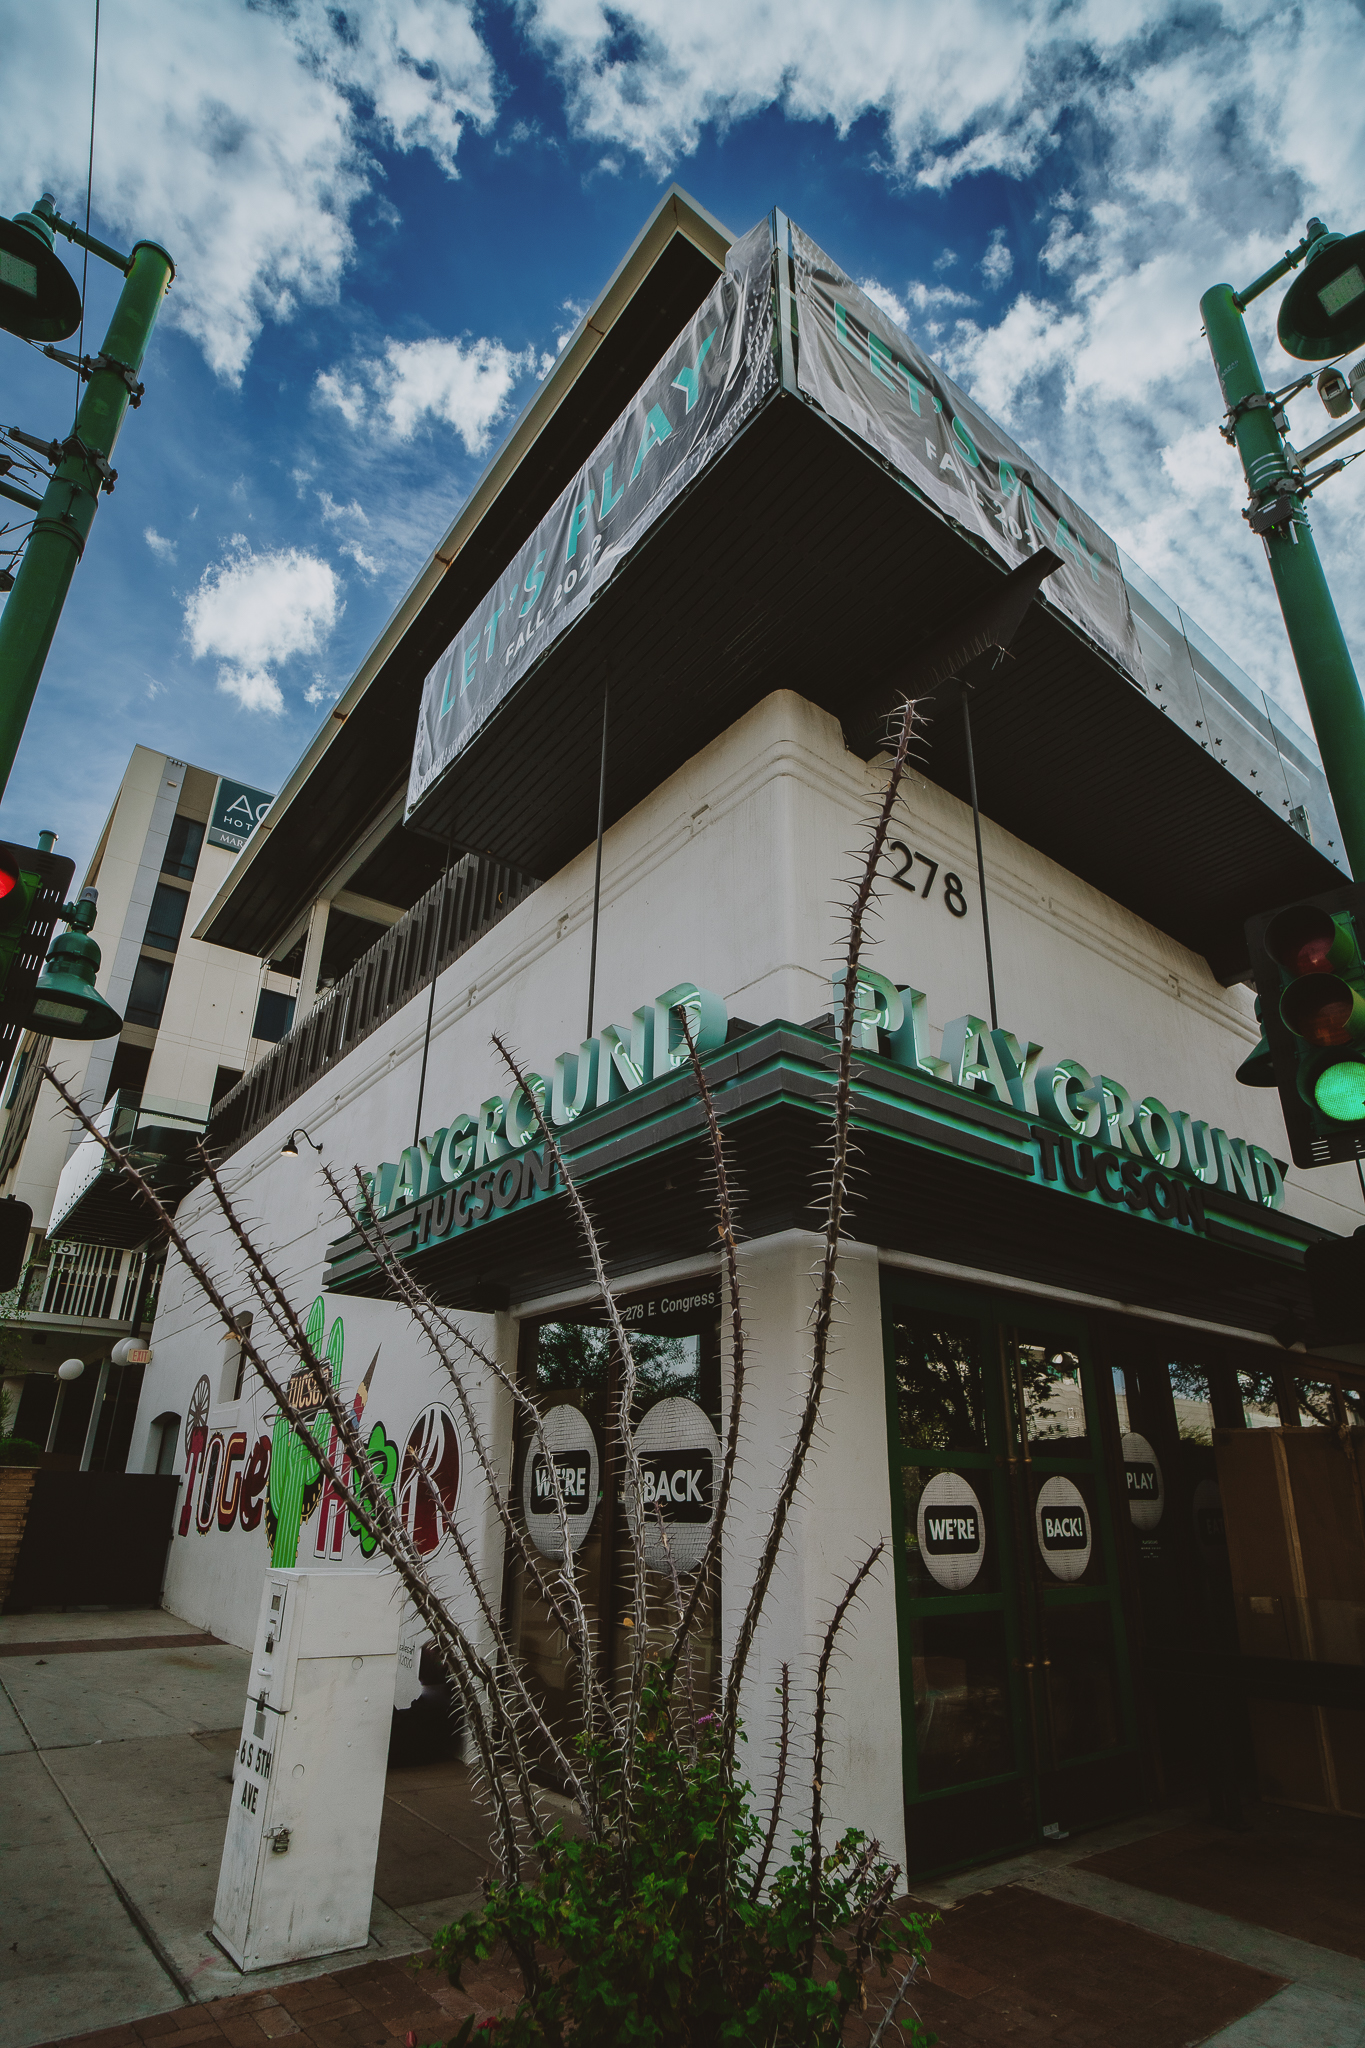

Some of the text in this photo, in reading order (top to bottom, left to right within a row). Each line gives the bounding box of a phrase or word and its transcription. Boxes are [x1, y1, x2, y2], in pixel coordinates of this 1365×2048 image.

[834, 300, 981, 468] LET'S
[438, 327, 717, 723] LET'S PLAY
[925, 437, 1045, 553] FAL 202
[504, 534, 602, 667] FALL 2022
[219, 834, 245, 848] MAR
[890, 841, 967, 917] 278
[356, 982, 727, 1222] PLAYGROUND
[832, 964, 1284, 1211] PLAYGROUND
[413, 1142, 557, 1244] TUCSON
[1031, 1125, 1208, 1233] TUCSON
[625, 1291, 715, 1321] 278 E. Congress
[132, 1350, 149, 1363] EXIT
[1126, 1472, 1154, 1489] PLAY
[928, 1518, 976, 1541] WE'RE
[1045, 1516, 1083, 1538] BACK!
[240, 1740, 272, 1779] 6 S 5TH
[241, 1780, 259, 1815] AVE
